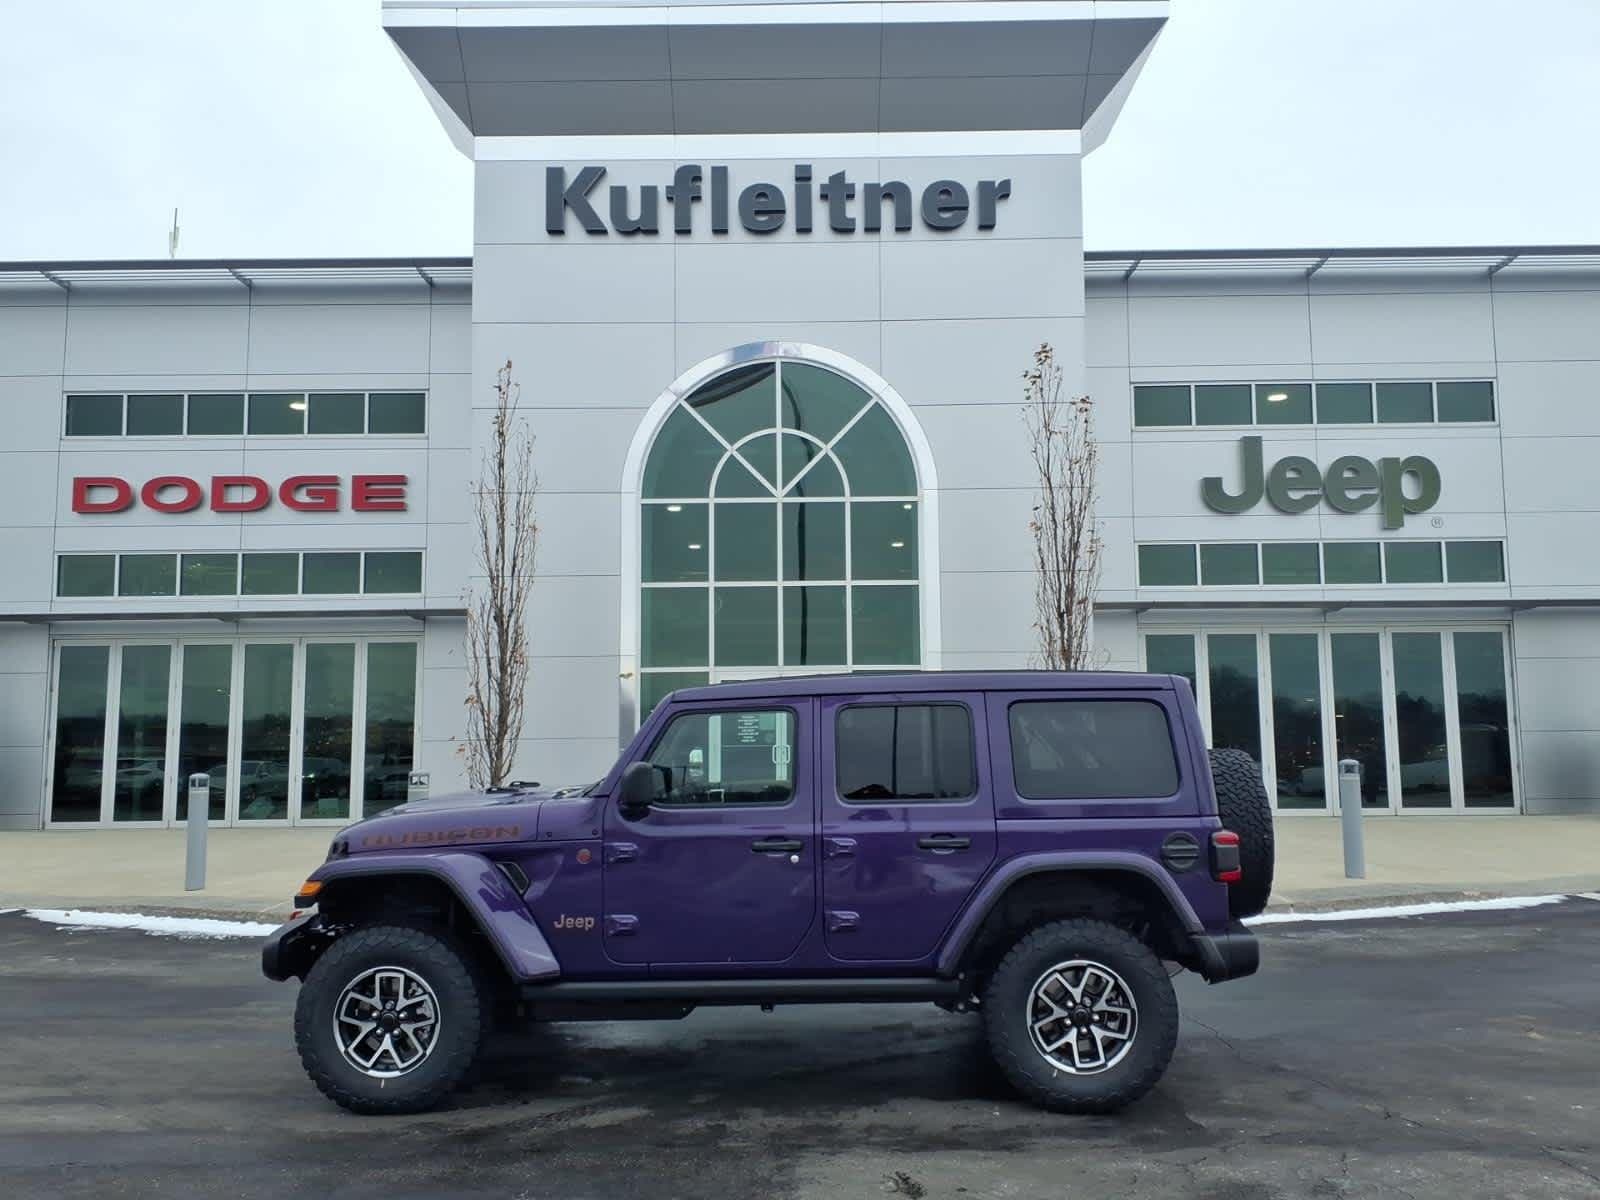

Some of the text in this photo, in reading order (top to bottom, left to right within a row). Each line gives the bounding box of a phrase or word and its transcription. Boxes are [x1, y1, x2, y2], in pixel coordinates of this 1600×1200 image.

[545, 164, 1011, 235] Kufleitner
[72, 475, 408, 513] DODGE
[1200, 436, 1441, 530] Jeep
[553, 914, 595, 931] Jeep
